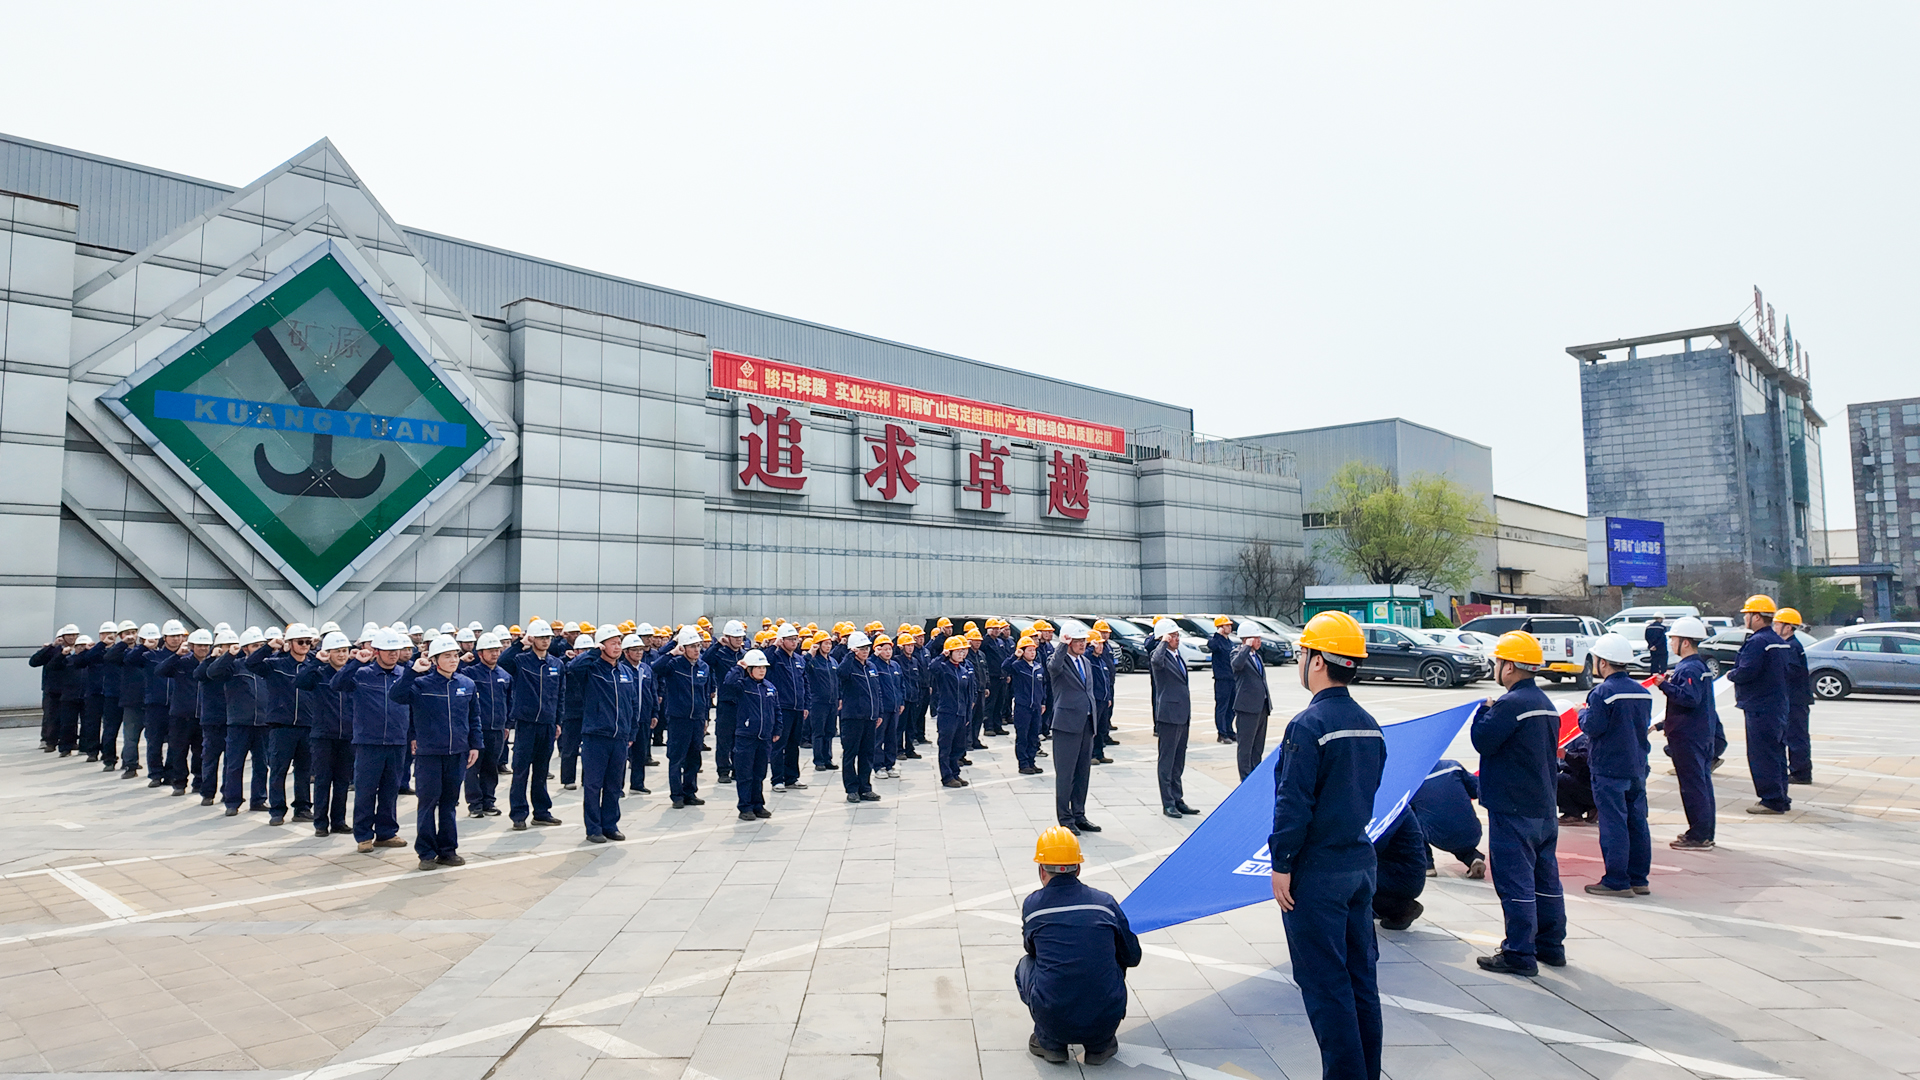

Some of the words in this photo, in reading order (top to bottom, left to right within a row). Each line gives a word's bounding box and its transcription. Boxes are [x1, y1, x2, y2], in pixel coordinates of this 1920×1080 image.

[764, 368, 827, 398] 骏马奔腾
[835, 382, 890, 409] 实业兴邦
[194, 399, 440, 443] KUANGYUAN
[739, 402, 1090, 519] 追求卓越
